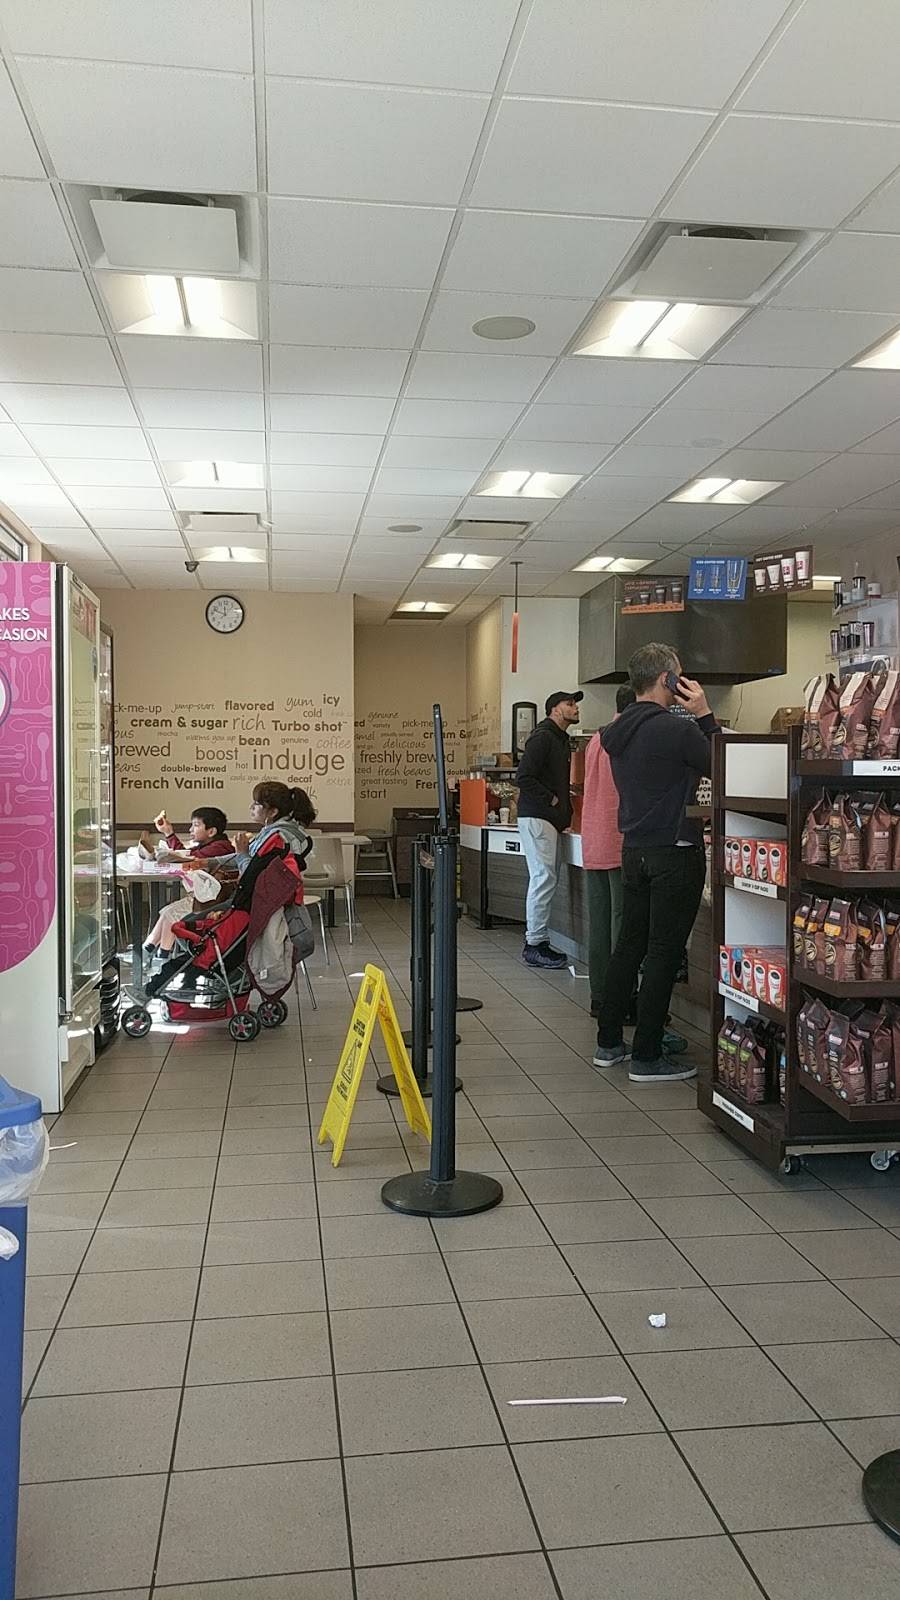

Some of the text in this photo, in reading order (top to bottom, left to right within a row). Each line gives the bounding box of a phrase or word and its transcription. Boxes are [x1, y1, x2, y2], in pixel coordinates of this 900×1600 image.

[0, 608, 30, 621] KES
[0, 628, 48, 641] ASION
[225, 700, 274, 711] flavored
[284, 697, 315, 712] yum
[323, 693, 340, 707] icy
[303, 708, 322, 718] cold
[130, 718, 172, 728] cream
[177, 716, 187, 728] &
[191, 719, 228, 731] sugar
[233, 713, 266, 731] rich
[272, 720, 310, 731] Turbo
[402, 719, 448, 730] pick-mep
[239, 734, 271, 746] bean
[423, 731, 456, 739] crm
[459, 729, 467, 739] &
[317, 735, 352, 749] coffee
[196, 746, 239, 761] boost
[360, 749, 455, 769] freshly brewd
[160, 764, 227, 772] double-brewed
[253, 748, 345, 776] indulge
[121, 776, 224, 789] French Vanilla
[287, 774, 312, 783] decaf
[360, 788, 386, 799] start
